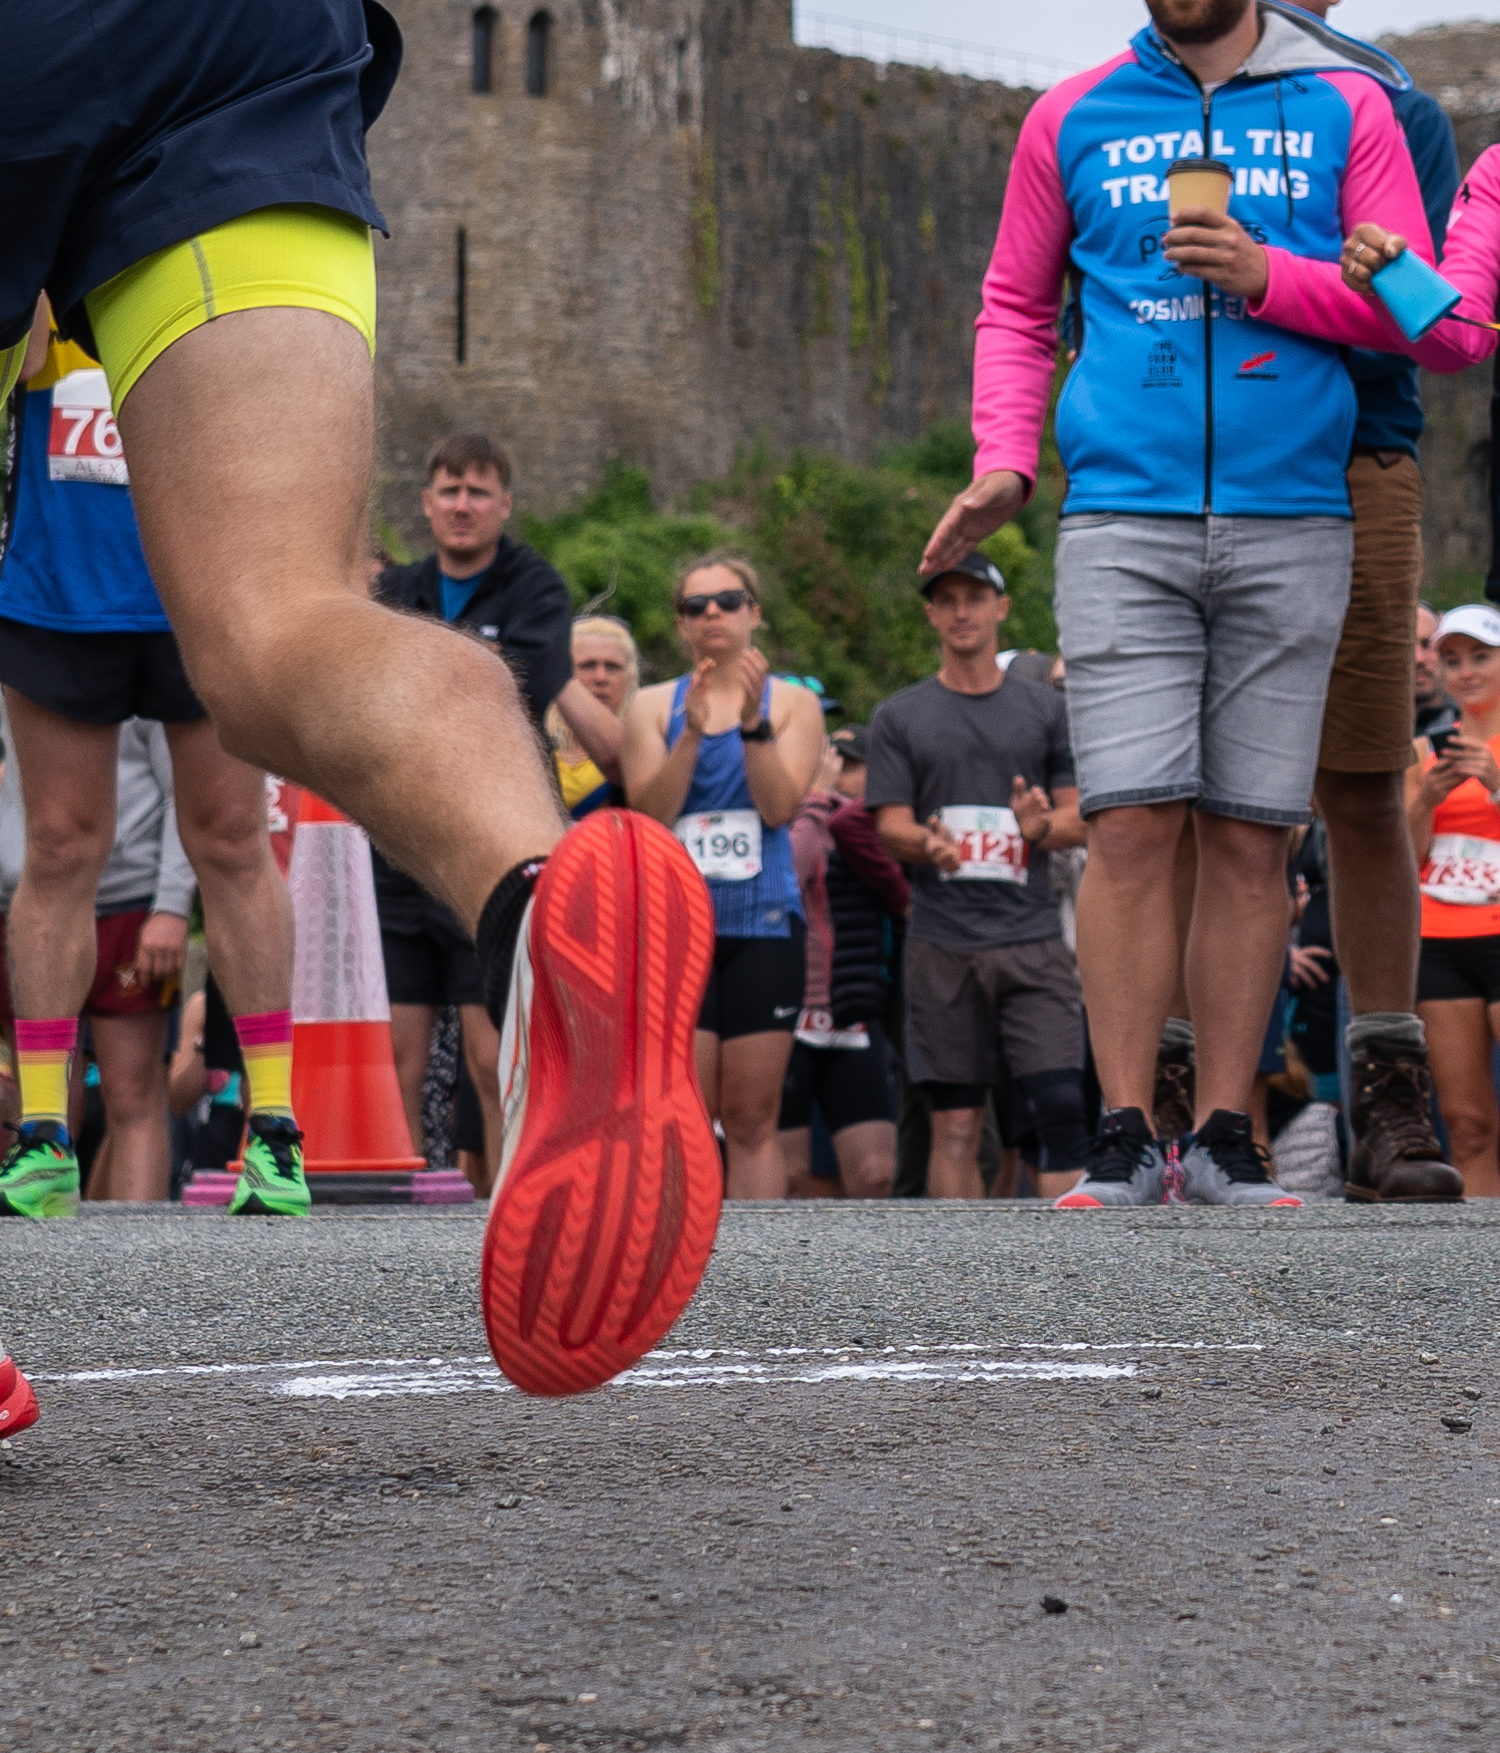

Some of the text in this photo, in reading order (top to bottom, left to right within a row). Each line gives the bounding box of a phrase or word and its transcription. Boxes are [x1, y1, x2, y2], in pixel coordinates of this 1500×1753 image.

[1102, 129, 1314, 167] TOTAL TRI
[1102, 167, 1311, 208] TRAING
[62, 408, 124, 458] 76
[682, 832, 750, 860] 196
